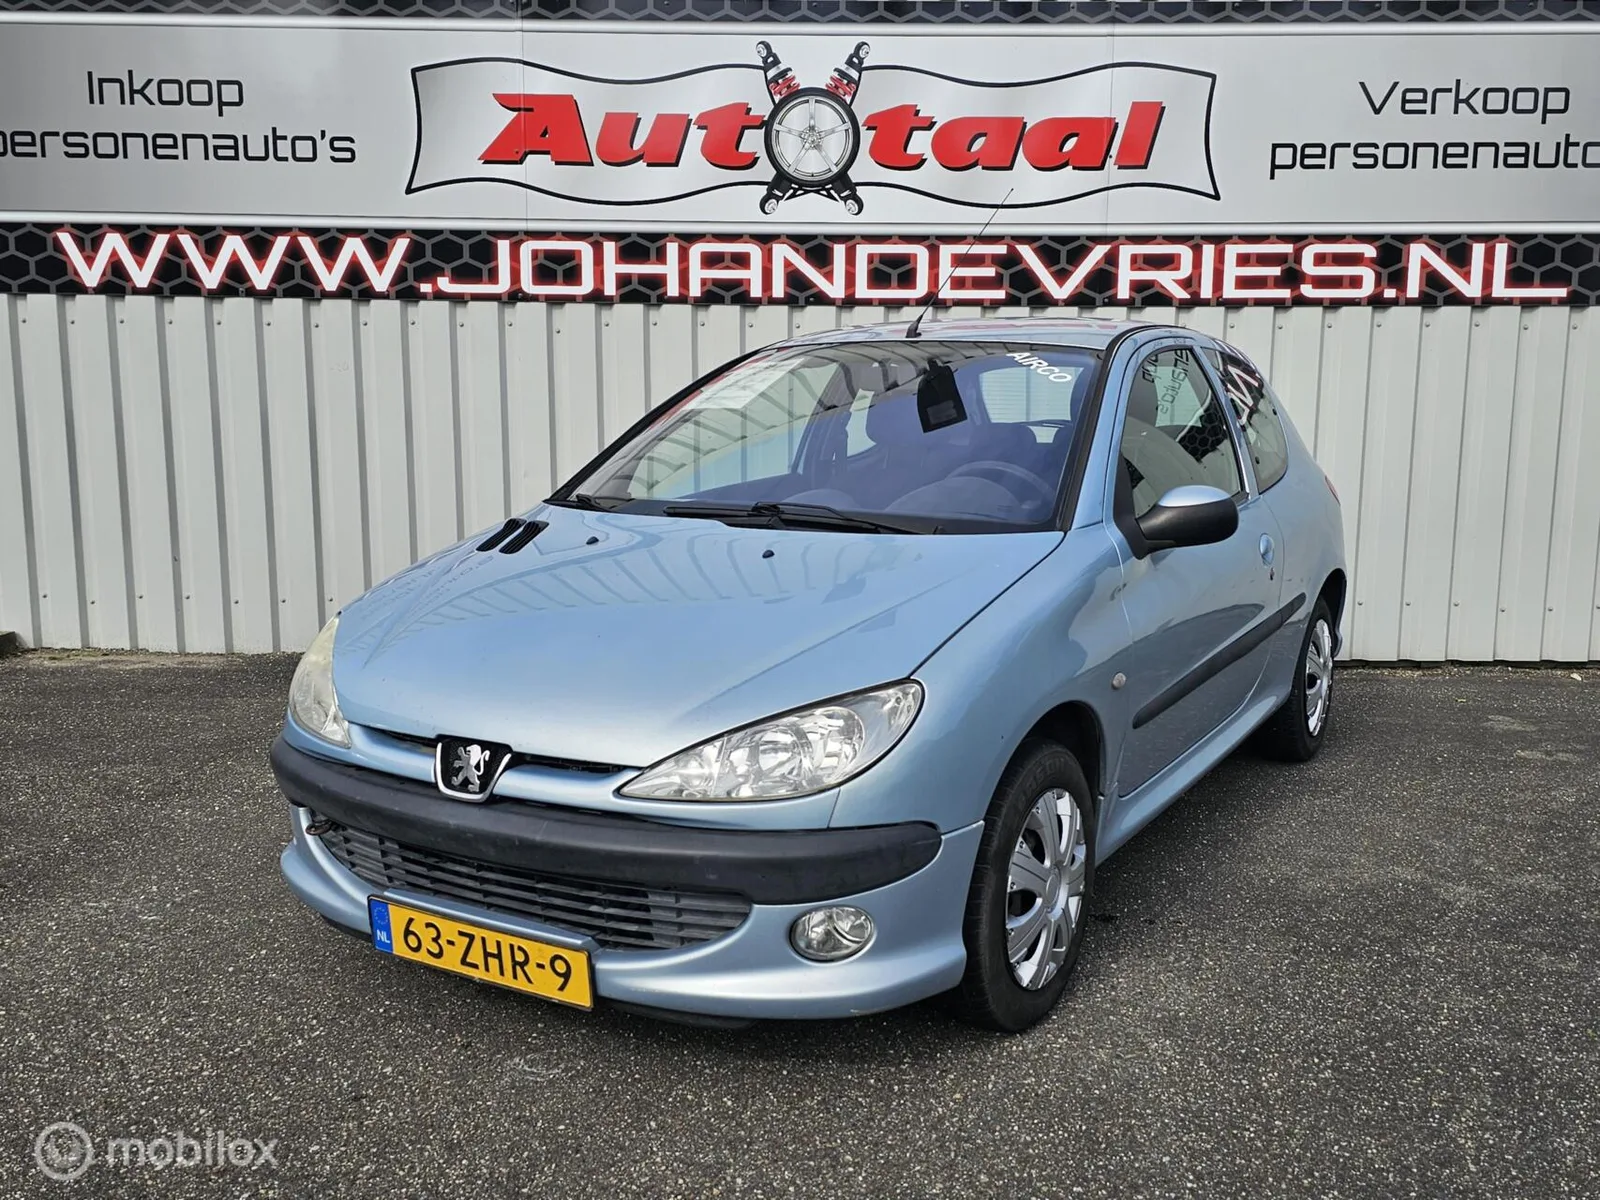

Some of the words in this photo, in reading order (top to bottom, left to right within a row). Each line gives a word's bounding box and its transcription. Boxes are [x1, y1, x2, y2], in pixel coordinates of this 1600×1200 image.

[87, 69, 244, 118] Inkoop
[1359, 79, 1571, 125] Verkoop
[56, 231, 1568, 300] WWW.JOHANDEVRIES.NL
[1006, 352, 1072, 382] AIRCO
[376, 929, 391, 944] NL
[402, 916, 573, 993] 63-ZHR-9
